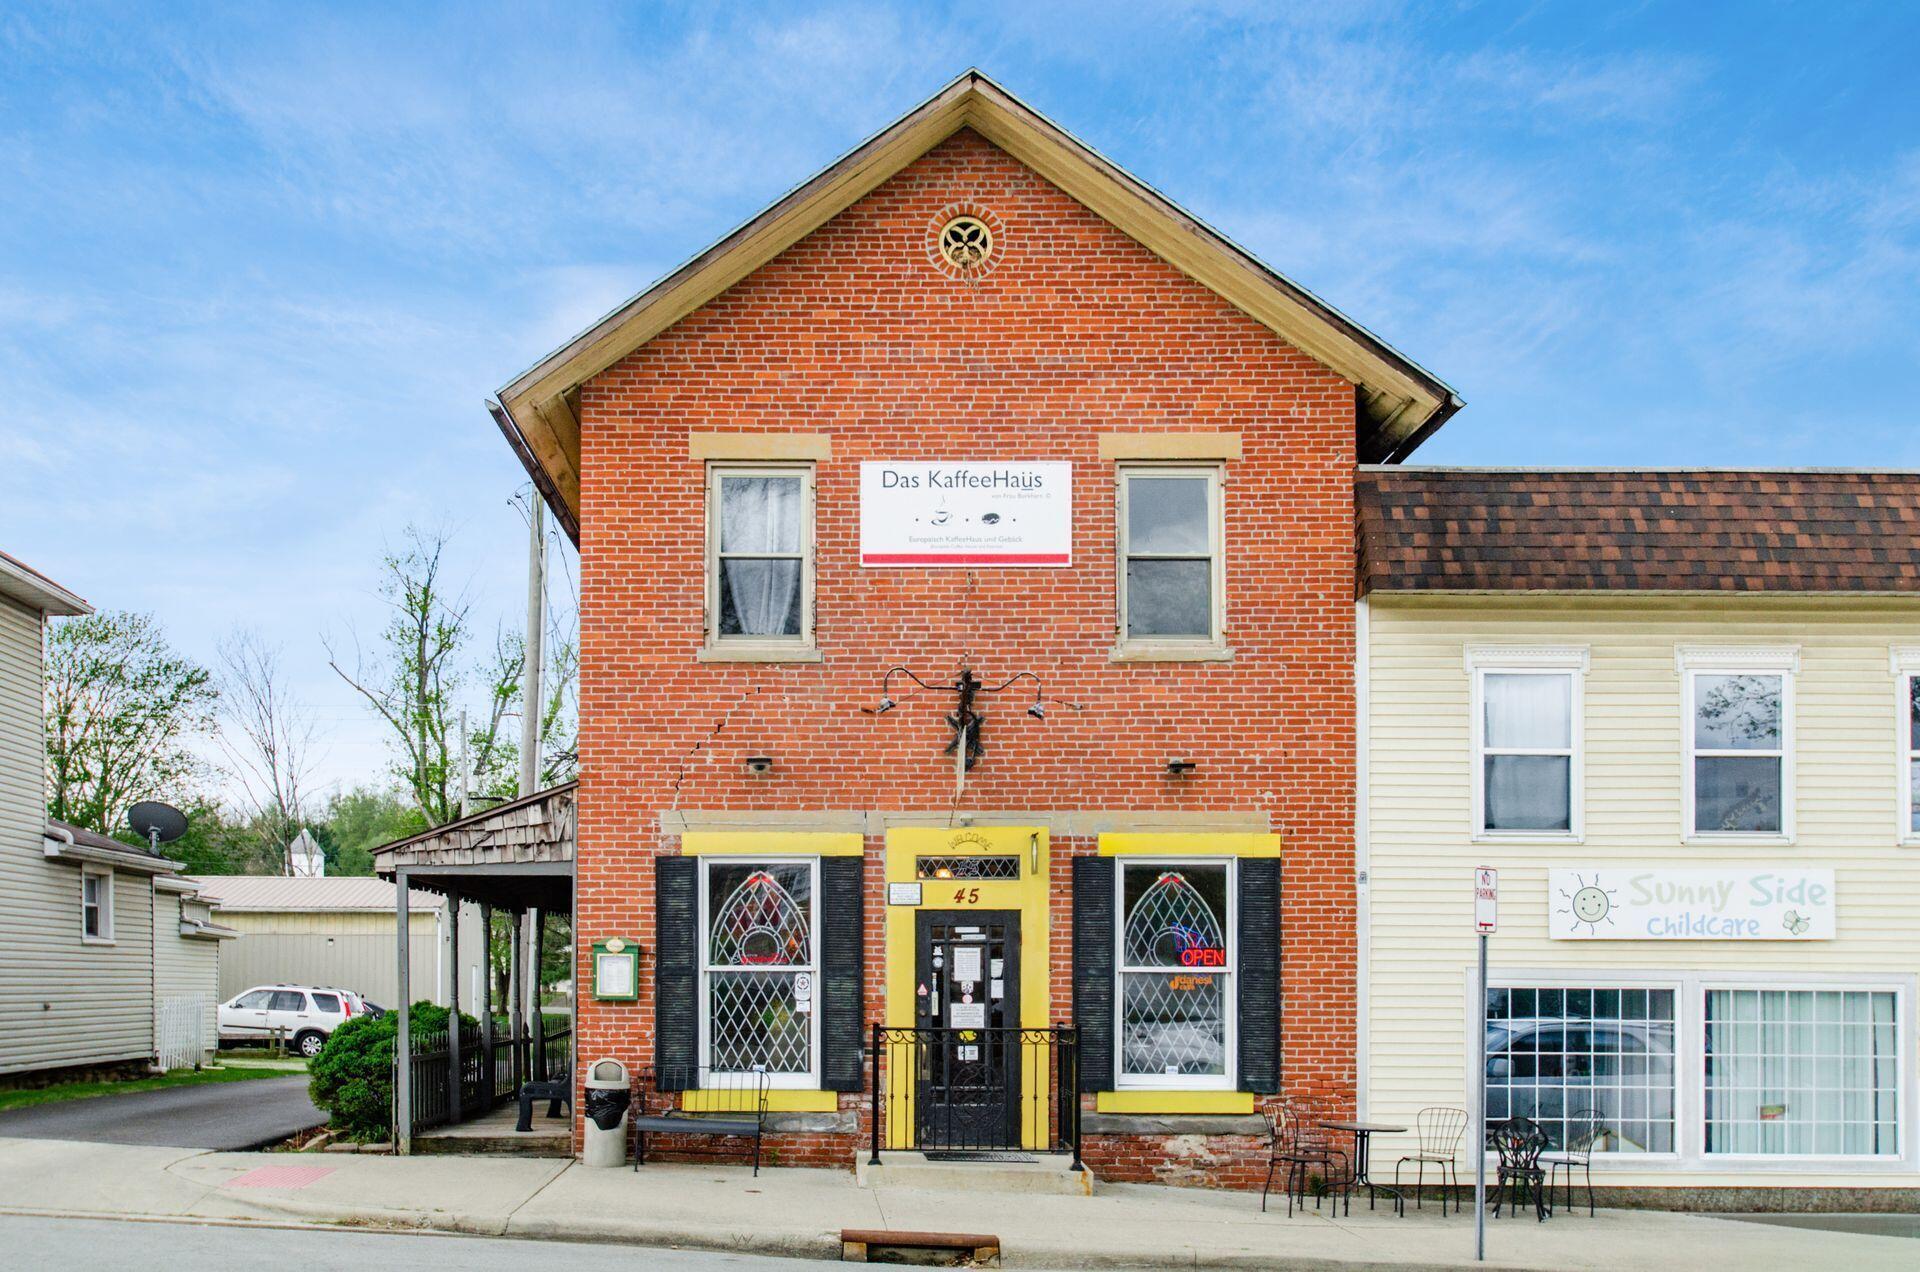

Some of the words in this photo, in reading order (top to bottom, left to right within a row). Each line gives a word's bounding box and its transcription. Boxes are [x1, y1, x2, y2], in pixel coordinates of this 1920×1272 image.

[882, 470, 920, 488] Das
[928, 470, 1043, 490] KaffeeHaüs
[953, 887, 980, 904] 45
[1629, 873, 1735, 913] Sunny
[1749, 874, 1827, 907] Side
[1181, 949, 1225, 966] OPEN
